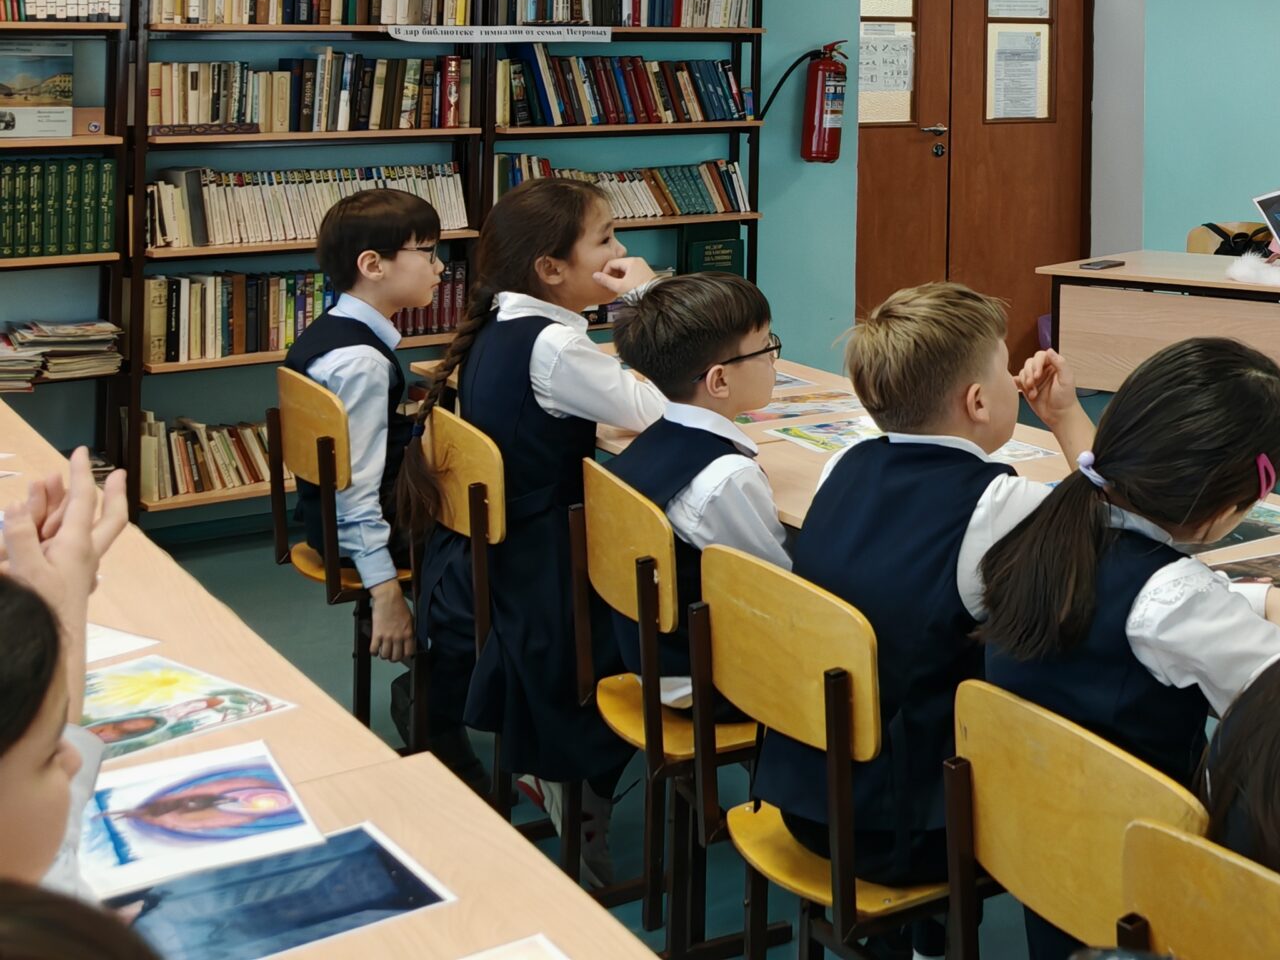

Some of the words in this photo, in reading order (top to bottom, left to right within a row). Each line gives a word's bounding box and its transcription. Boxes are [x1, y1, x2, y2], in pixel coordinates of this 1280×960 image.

[394, 27, 401, 35] В
[403, 28, 420, 37] дар
[421, 27, 474, 36] библиотеке
[566, 28, 607, 37] Петровых
